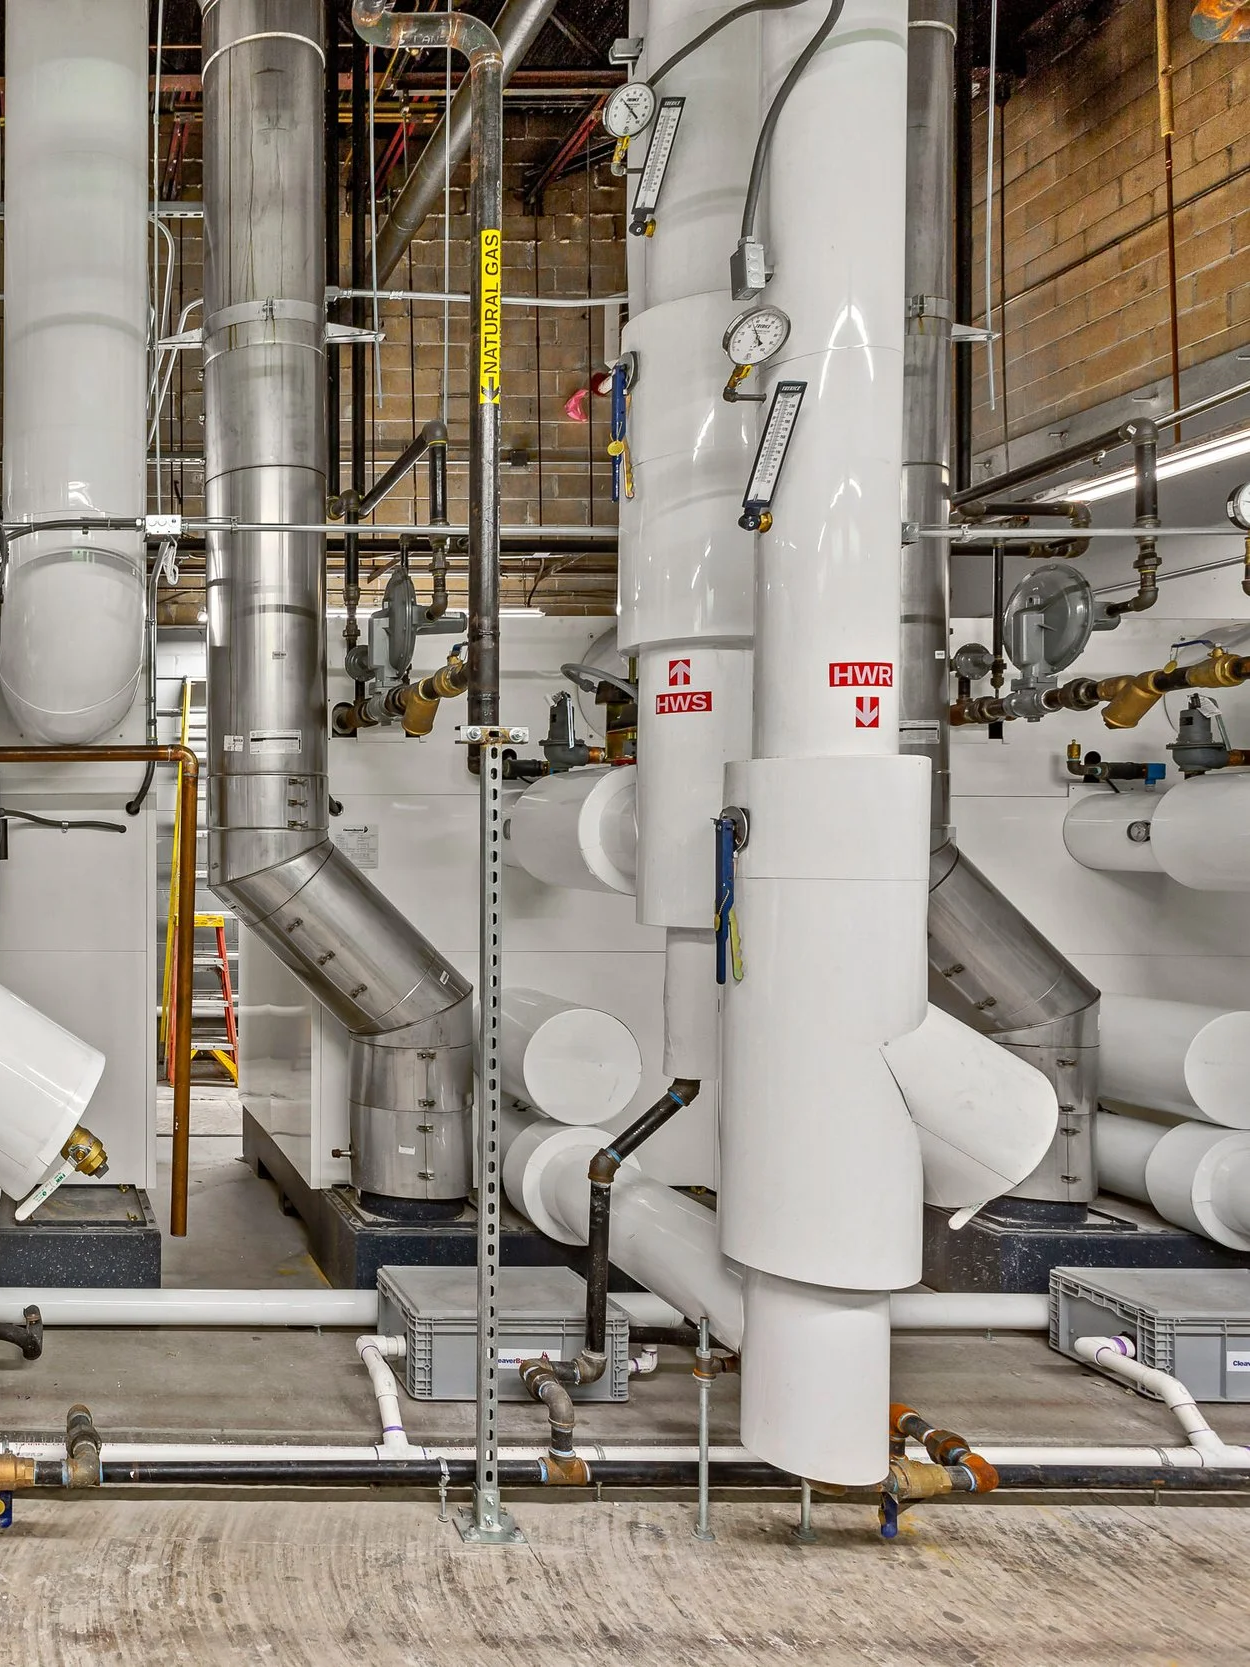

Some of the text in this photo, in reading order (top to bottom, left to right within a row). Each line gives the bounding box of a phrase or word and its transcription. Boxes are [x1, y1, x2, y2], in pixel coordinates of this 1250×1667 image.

[483, 234, 499, 374] NATURAL GAS
[833, 665, 892, 686] HWR
[656, 693, 708, 714] HWS
